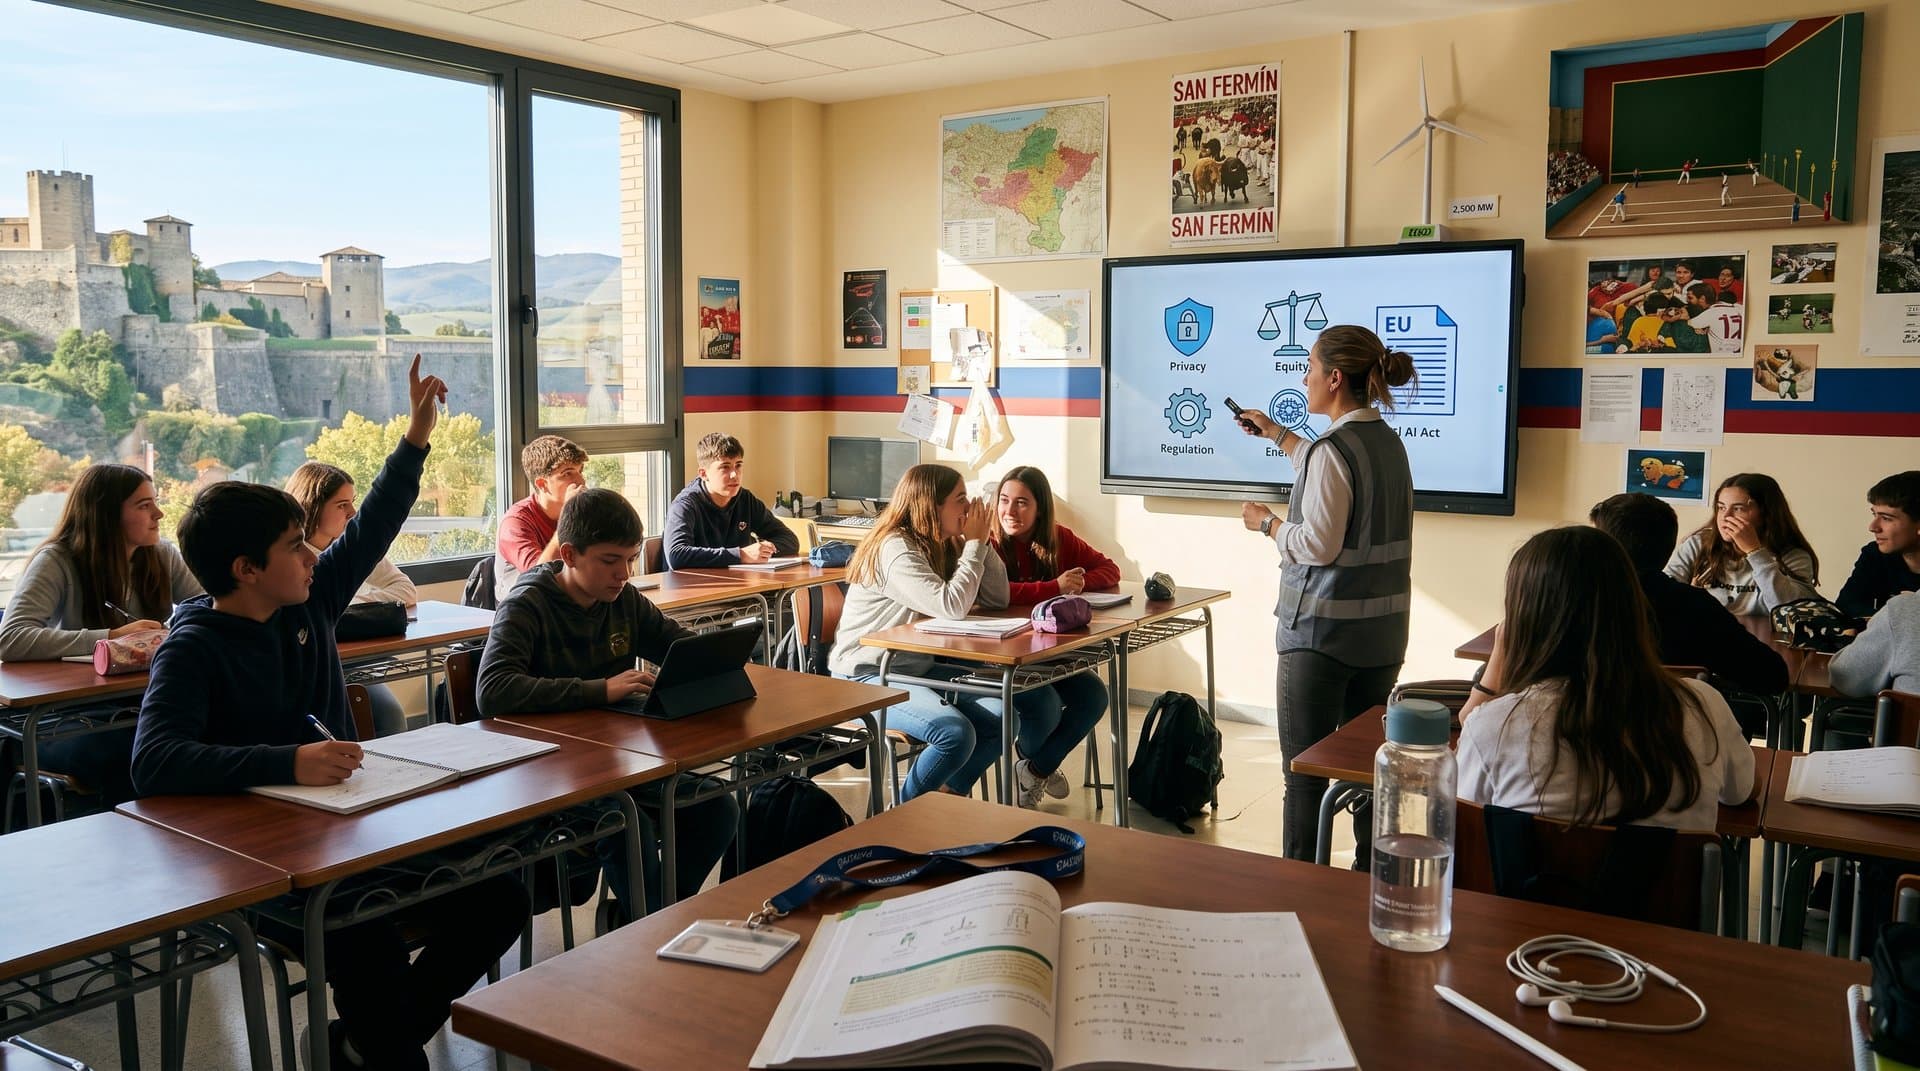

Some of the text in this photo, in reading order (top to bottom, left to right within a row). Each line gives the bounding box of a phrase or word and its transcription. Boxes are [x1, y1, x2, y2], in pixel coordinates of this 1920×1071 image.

[1173, 65, 1278, 102] SAN FERMÍN
[1453, 203, 1494, 214] 2,500 MW
[1172, 206, 1274, 237] SAN FERMÍN
[1385, 316, 1411, 333] EU
[1170, 362, 1206, 373] Privacy
[1275, 361, 1309, 374] Equity
[1405, 427, 1417, 437] AI
[1420, 427, 1441, 438] Act
[1161, 444, 1214, 456] Regulation
